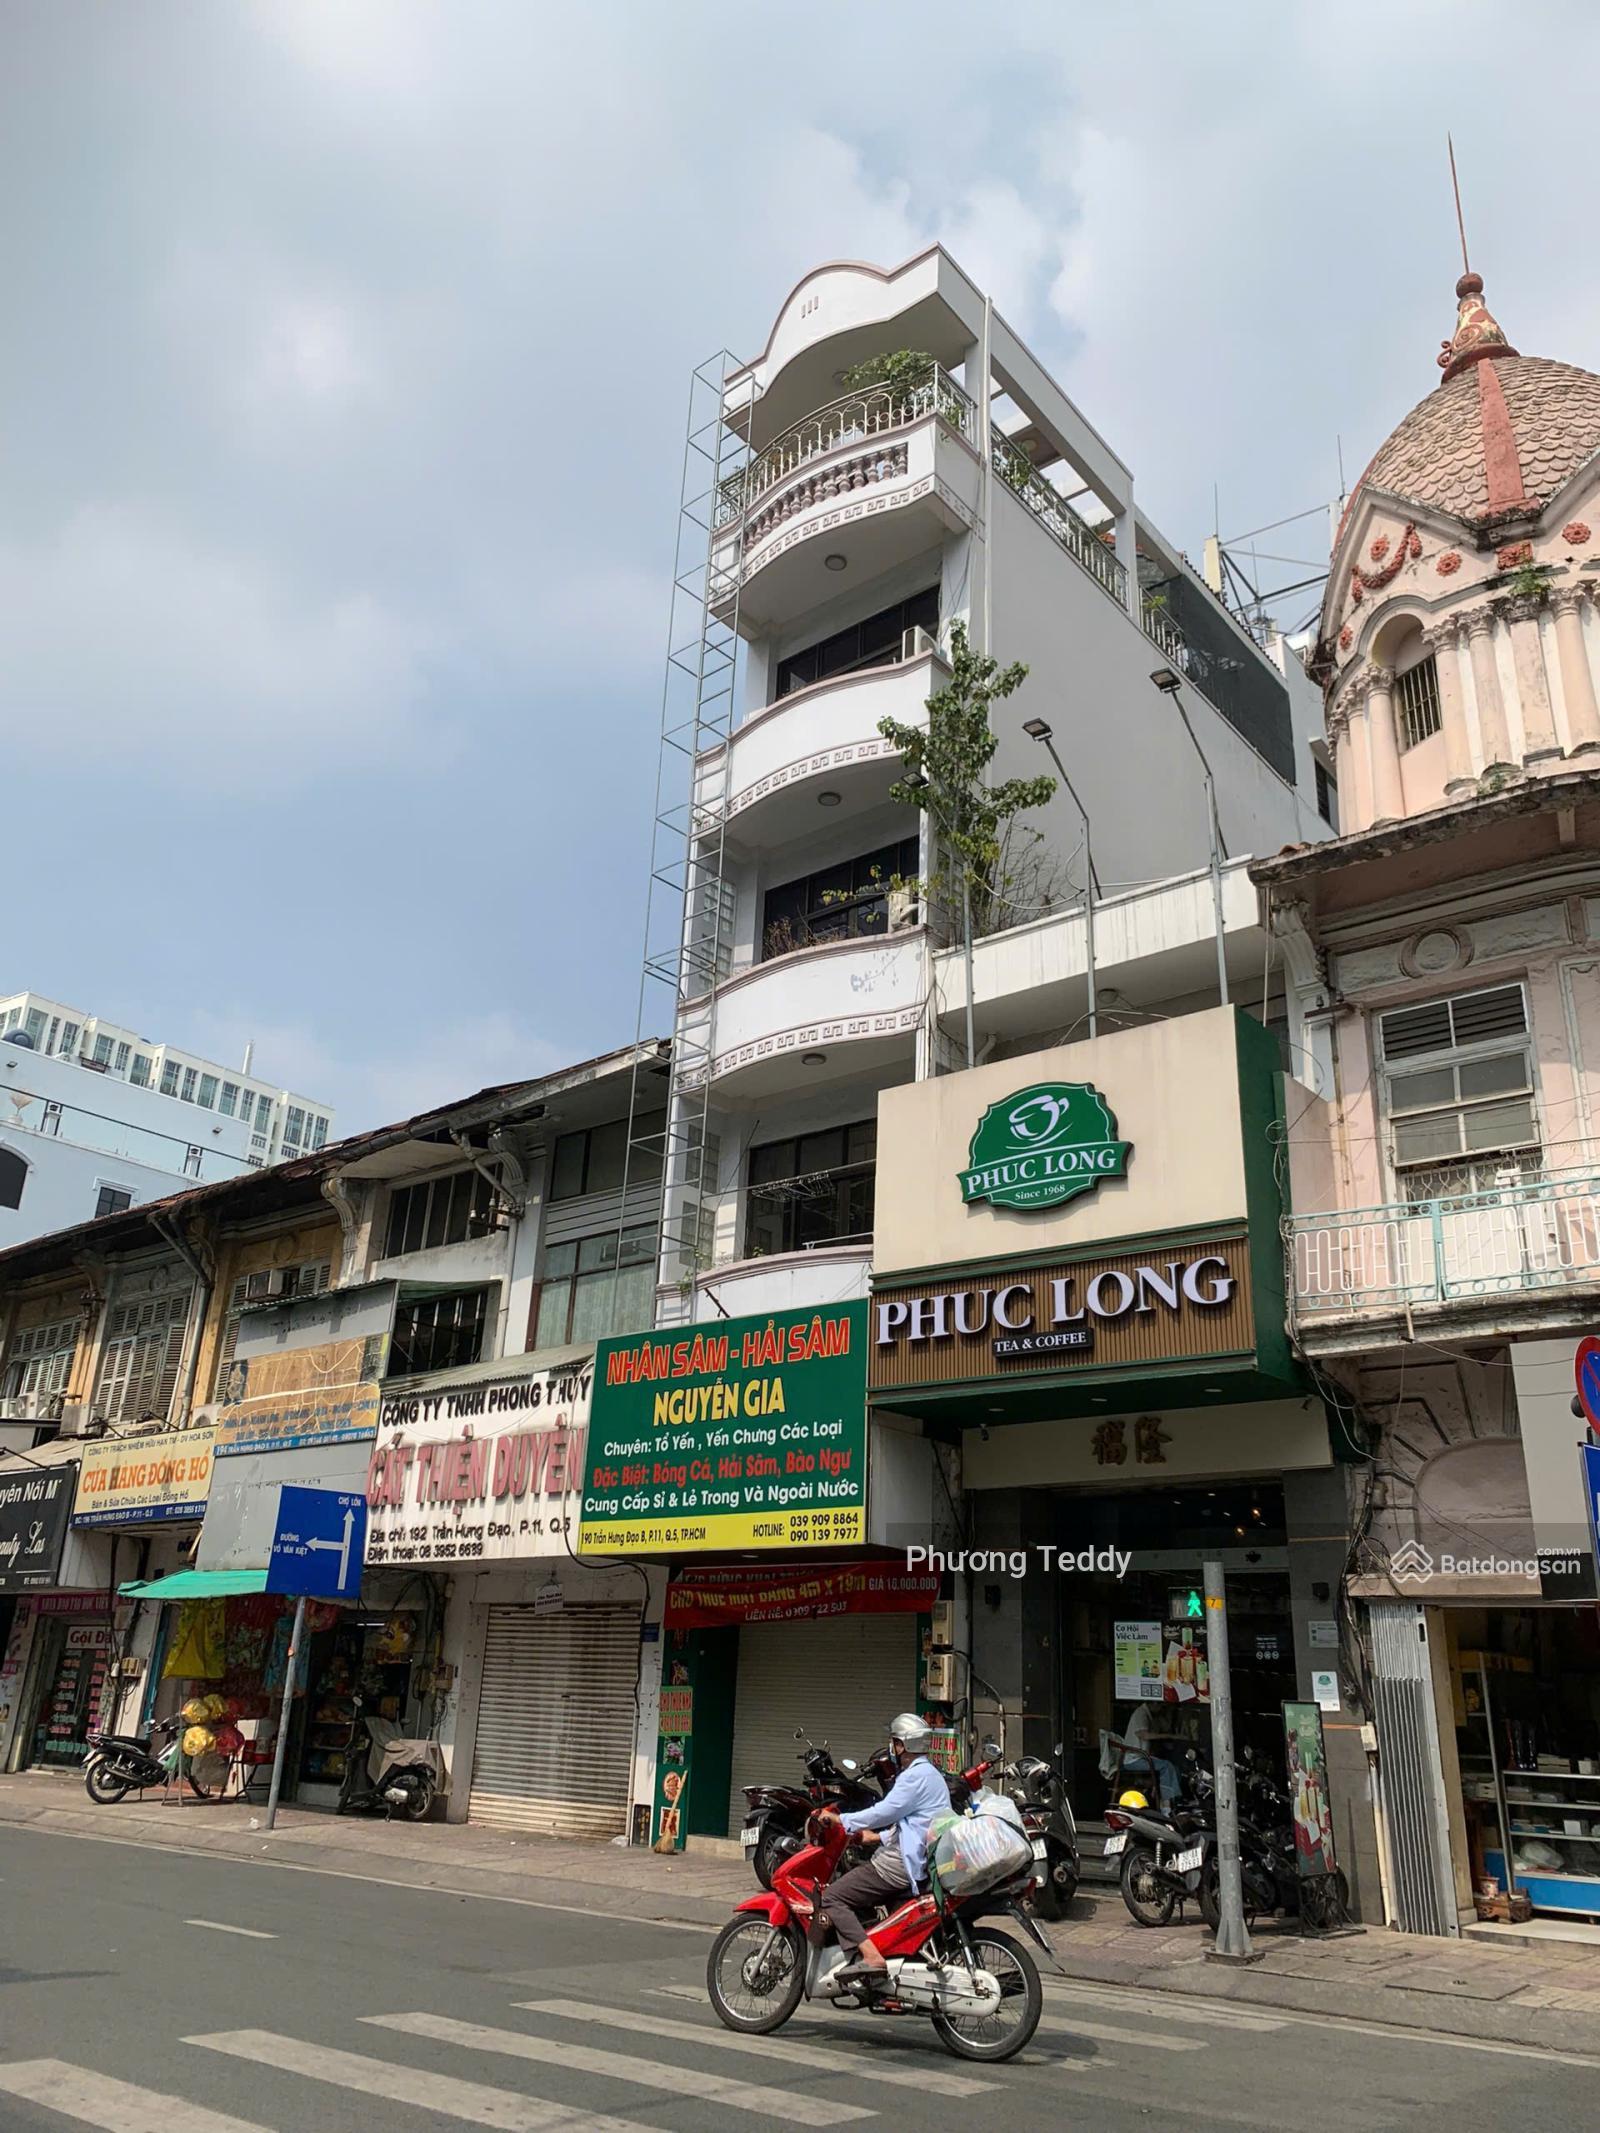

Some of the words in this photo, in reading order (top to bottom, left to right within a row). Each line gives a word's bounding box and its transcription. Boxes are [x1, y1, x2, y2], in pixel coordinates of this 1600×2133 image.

[966, 1159, 1036, 1195] PHUC
[1044, 1149, 1116, 1175] LONG
[1014, 1190, 1041, 1201] Since
[1044, 1184, 1066, 1197] 1968
[874, 1284, 1032, 1345] PHUC
[1049, 1256, 1237, 1323] LONG
[606, 1340, 670, 1386] NHÂN
[671, 1333, 729, 1378] SÂM
[742, 1320, 784, 1369] HẢI
[787, 1315, 851, 1363] SÂM
[994, 1339, 1020, 1354] TEA
[1021, 1338, 1033, 1350] &
[1035, 1331, 1087, 1347] COFFEE
[423, 1397, 444, 1422] TY
[447, 1391, 486, 1419] TNHH
[488, 1382, 541, 1414] PHONG
[653, 1377, 740, 1426] NGUYỄN
[743, 1377, 786, 1417] GIA
[604, 1438, 651, 1457] Chuyên:
[655, 1432, 669, 1452] Tổ
[672, 1432, 695, 1450] Yến
[706, 1428, 729, 1447] Yến
[732, 1428, 776, 1446] Chưng
[780, 1422, 809, 1440] Các
[813, 1419, 842, 1440] Loại
[653, 1461, 687, 1488] Bóng
[690, 1457, 714, 1483] Cá,
[718, 1453, 743, 1479] Hải
[746, 1453, 782, 1478] Sâm,
[819, 1447, 852, 1477] Ngư
[585, 1498, 618, 1515] Cung
[622, 1491, 650, 1512] Cấp
[653, 1492, 666, 1509] Sỉ
[668, 1493, 678, 1507] &
[682, 1488, 697, 1506] Lẻ
[701, 1490, 739, 1508] Trong
[744, 1485, 764, 1503] Và
[768, 1482, 813, 1505] Ngoài
[817, 1478, 859, 1498] Nước
[409, 1527, 427, 1541] 192
[454, 1524, 484, 1541] Hưng
[681, 1527, 706, 1541] TP.HCM
[753, 1522, 785, 1537] HOTLINE:
[790, 1515, 808, 1527] 039
[811, 1514, 830, 1526] 909
[833, 1512, 858, 1525] 8864
[790, 1530, 808, 1542] 090
[813, 1529, 830, 1541] 139
[833, 1527, 859, 1540] 7977
